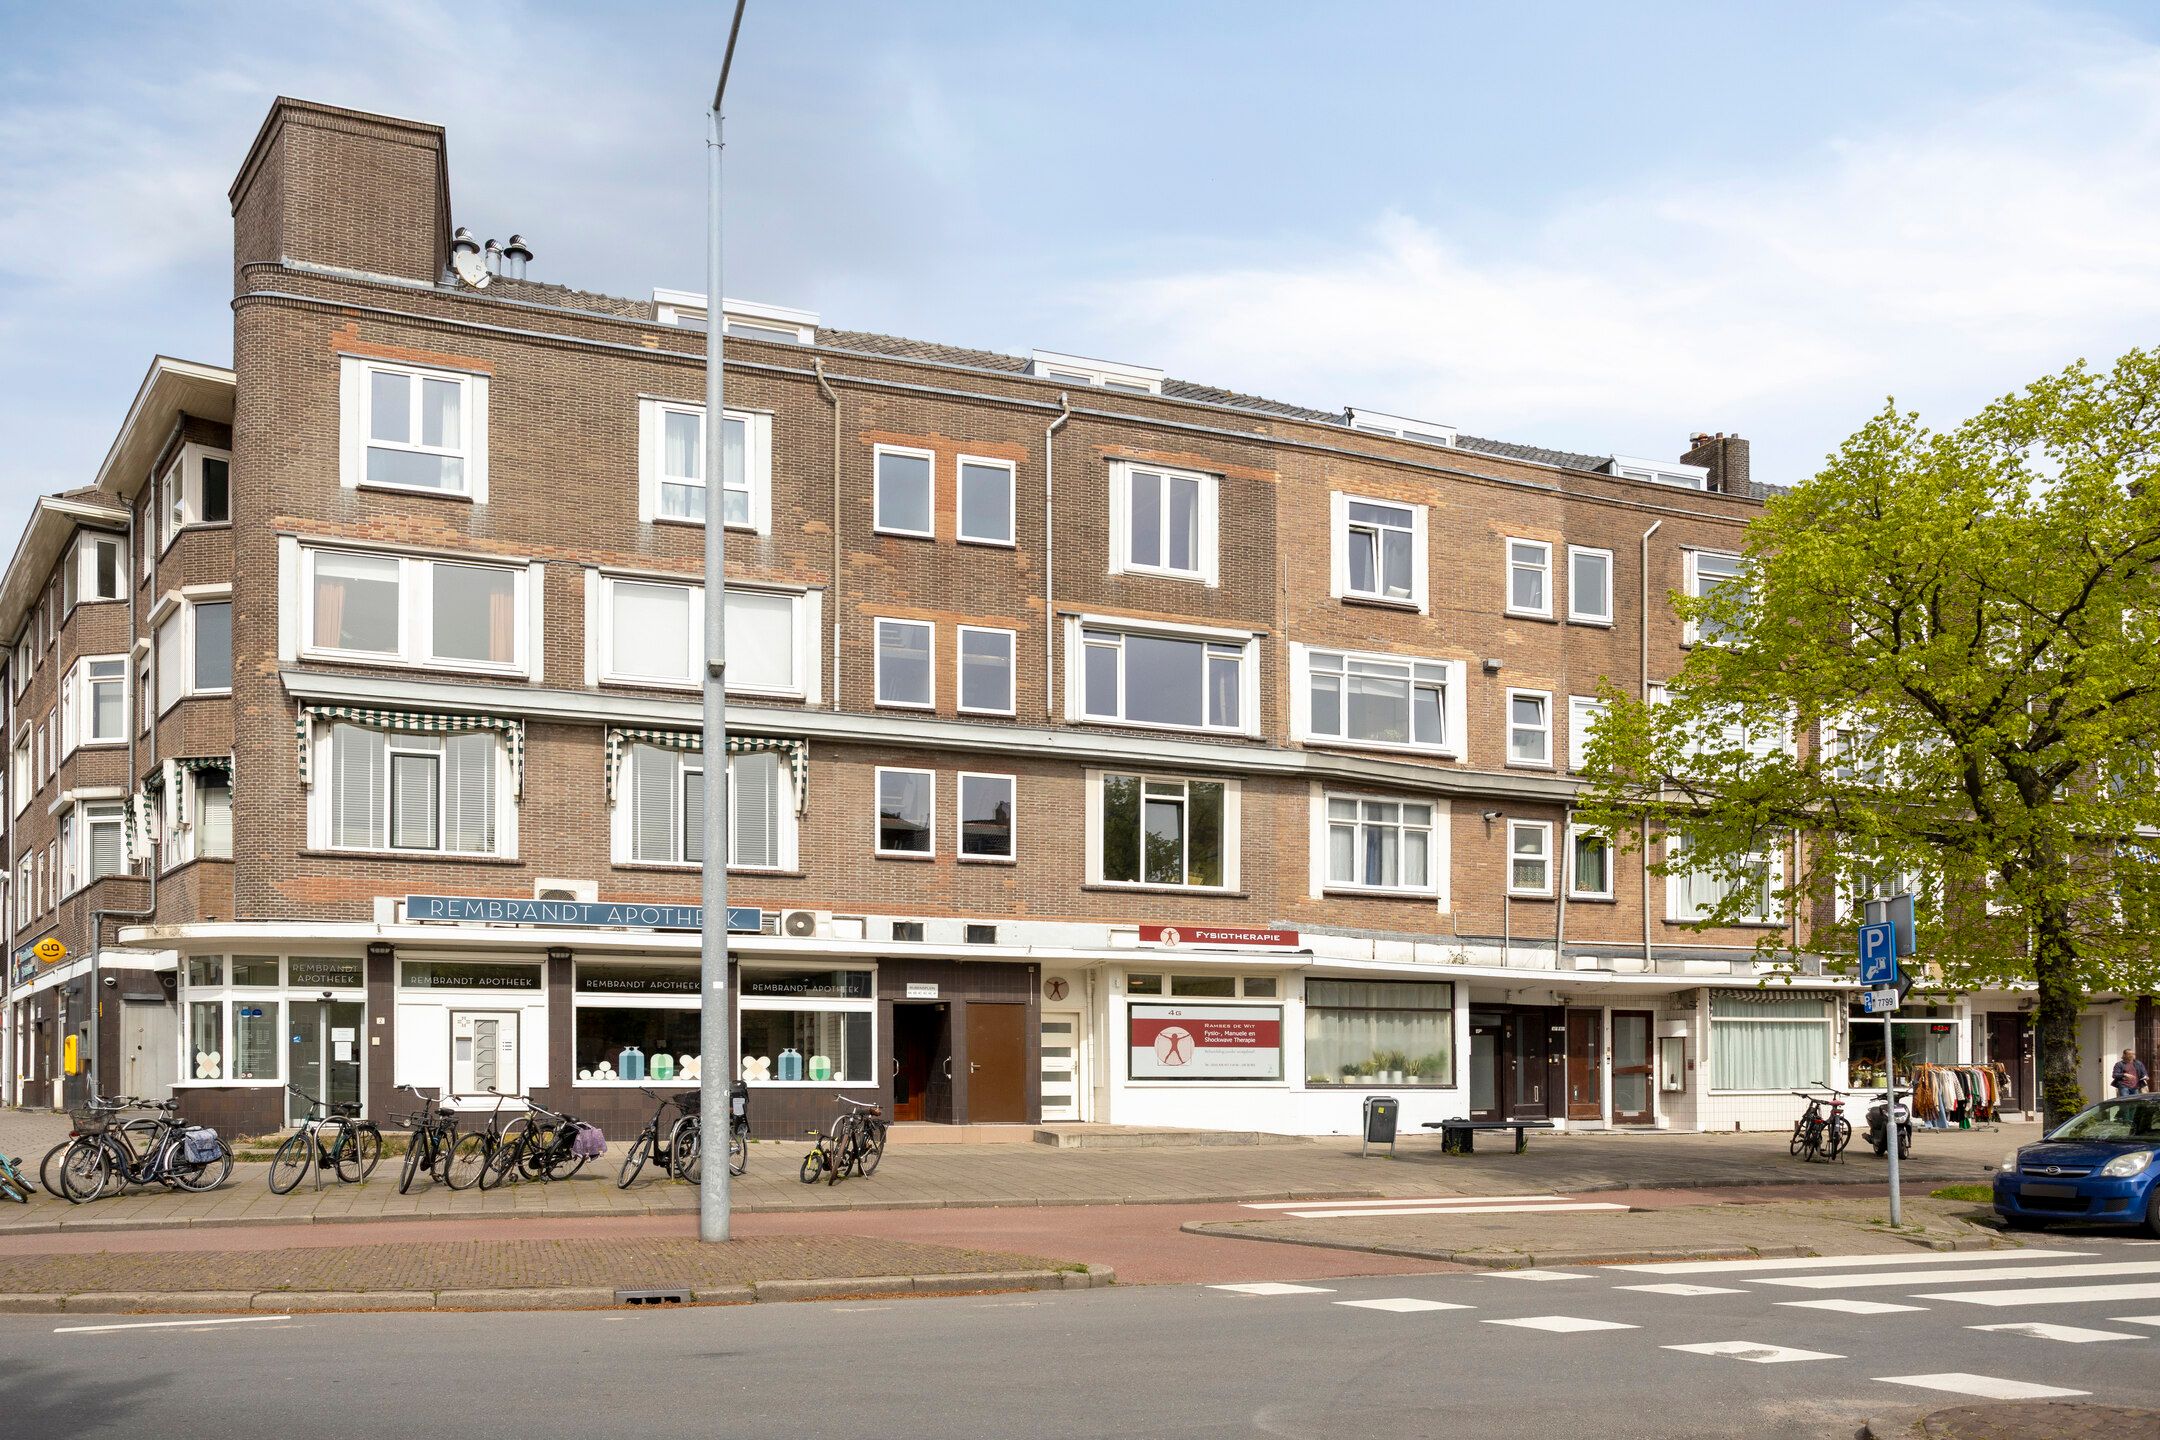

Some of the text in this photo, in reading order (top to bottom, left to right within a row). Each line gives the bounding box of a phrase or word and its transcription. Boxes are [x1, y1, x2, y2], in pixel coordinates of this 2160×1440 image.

[430, 899, 739, 927] REMBRANDT APOTHEK
[1196, 931, 1281, 941] FYSIOTHERAPIE
[1866, 928, 1884, 958] P
[292, 964, 358, 973] REMBRANDT
[297, 974, 354, 983] APOTHEEK
[410, 976, 532, 986] REMBRANDT APOTHEEK
[586, 980, 700, 990] REMBRANDT APOTHEEK
[752, 983, 808, 992] REMBRANDT
[1877, 997, 1894, 1007] 7799
[1234, 1036, 1256, 1044] Therapie
